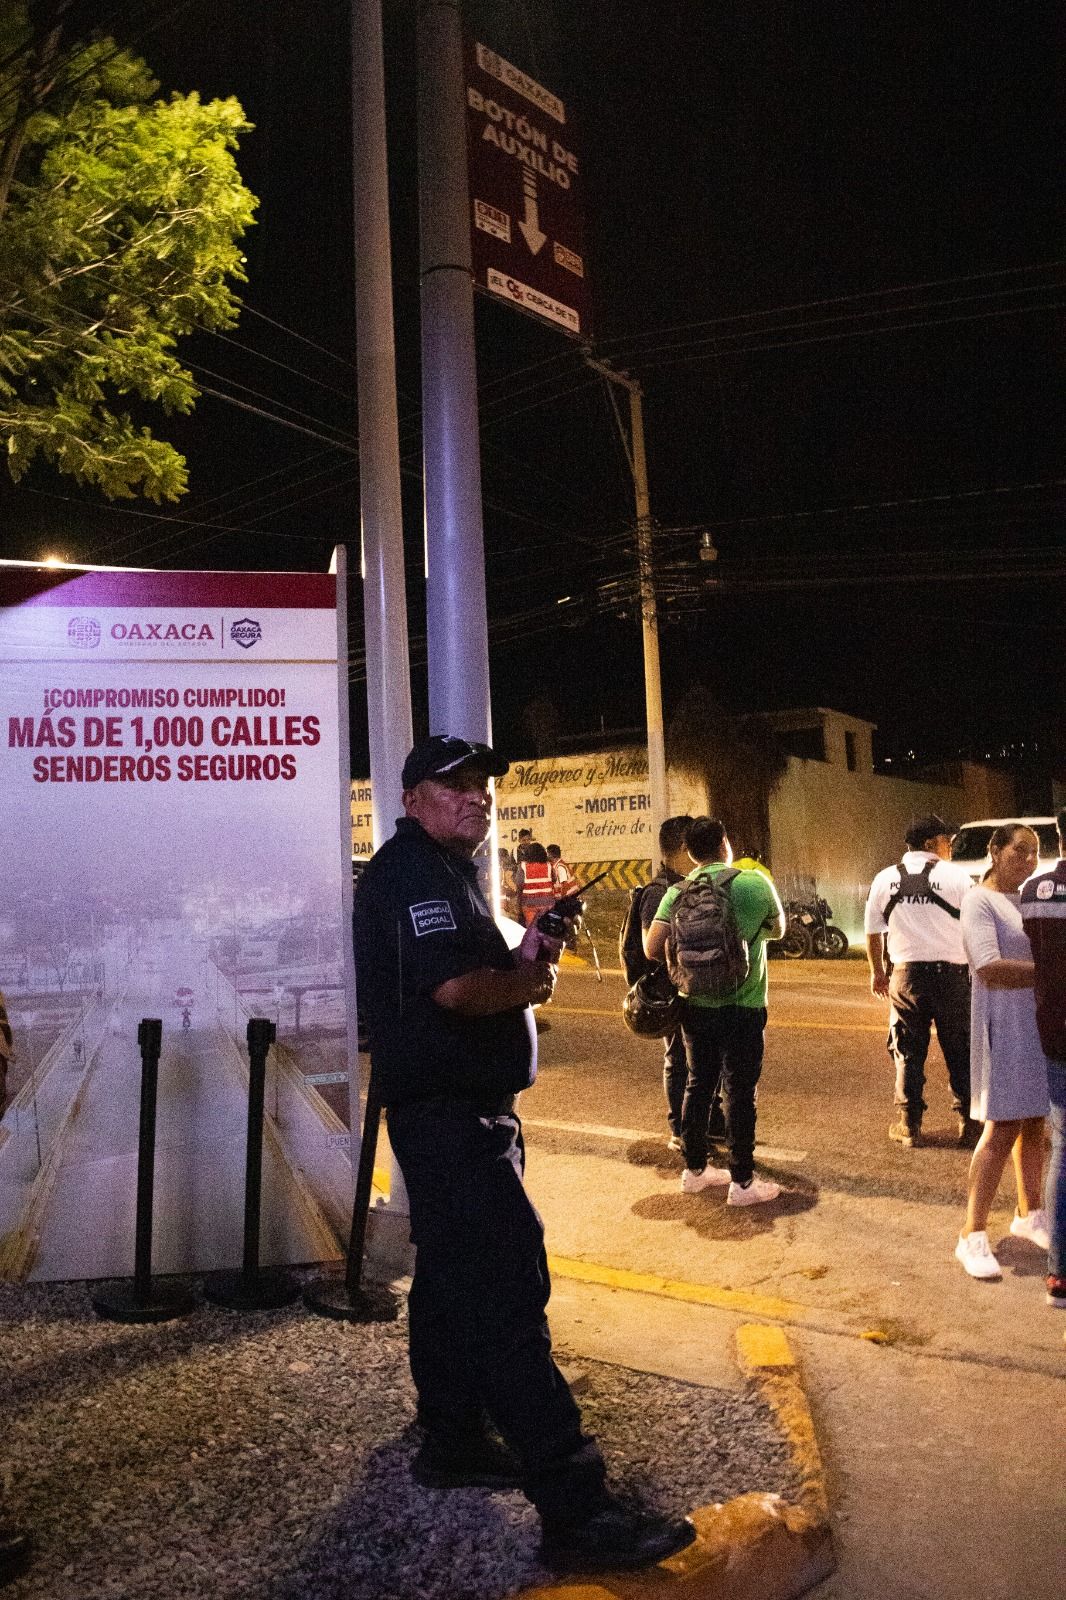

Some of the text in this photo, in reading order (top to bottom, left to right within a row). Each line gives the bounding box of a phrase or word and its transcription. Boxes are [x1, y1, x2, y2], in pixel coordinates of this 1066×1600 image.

[467, 86, 579, 175] BOTÓN DE
[481, 123, 571, 190] AUXILIO
[110, 622, 215, 641] OAXACA
[230, 632, 262, 640] SEGURA
[44, 688, 287, 708] ¡COMPROMISO CUMPLIDO!
[8, 706, 321, 752] MÁS DE 1,000 CALLES
[33, 753, 298, 782] SENDEROS SEGUROS
[510, 765, 582, 797] Mayoreo
[584, 768, 598, 788] y
[586, 817, 646, 838] Retiro de
[418, 915, 451, 928] SOCIAL
